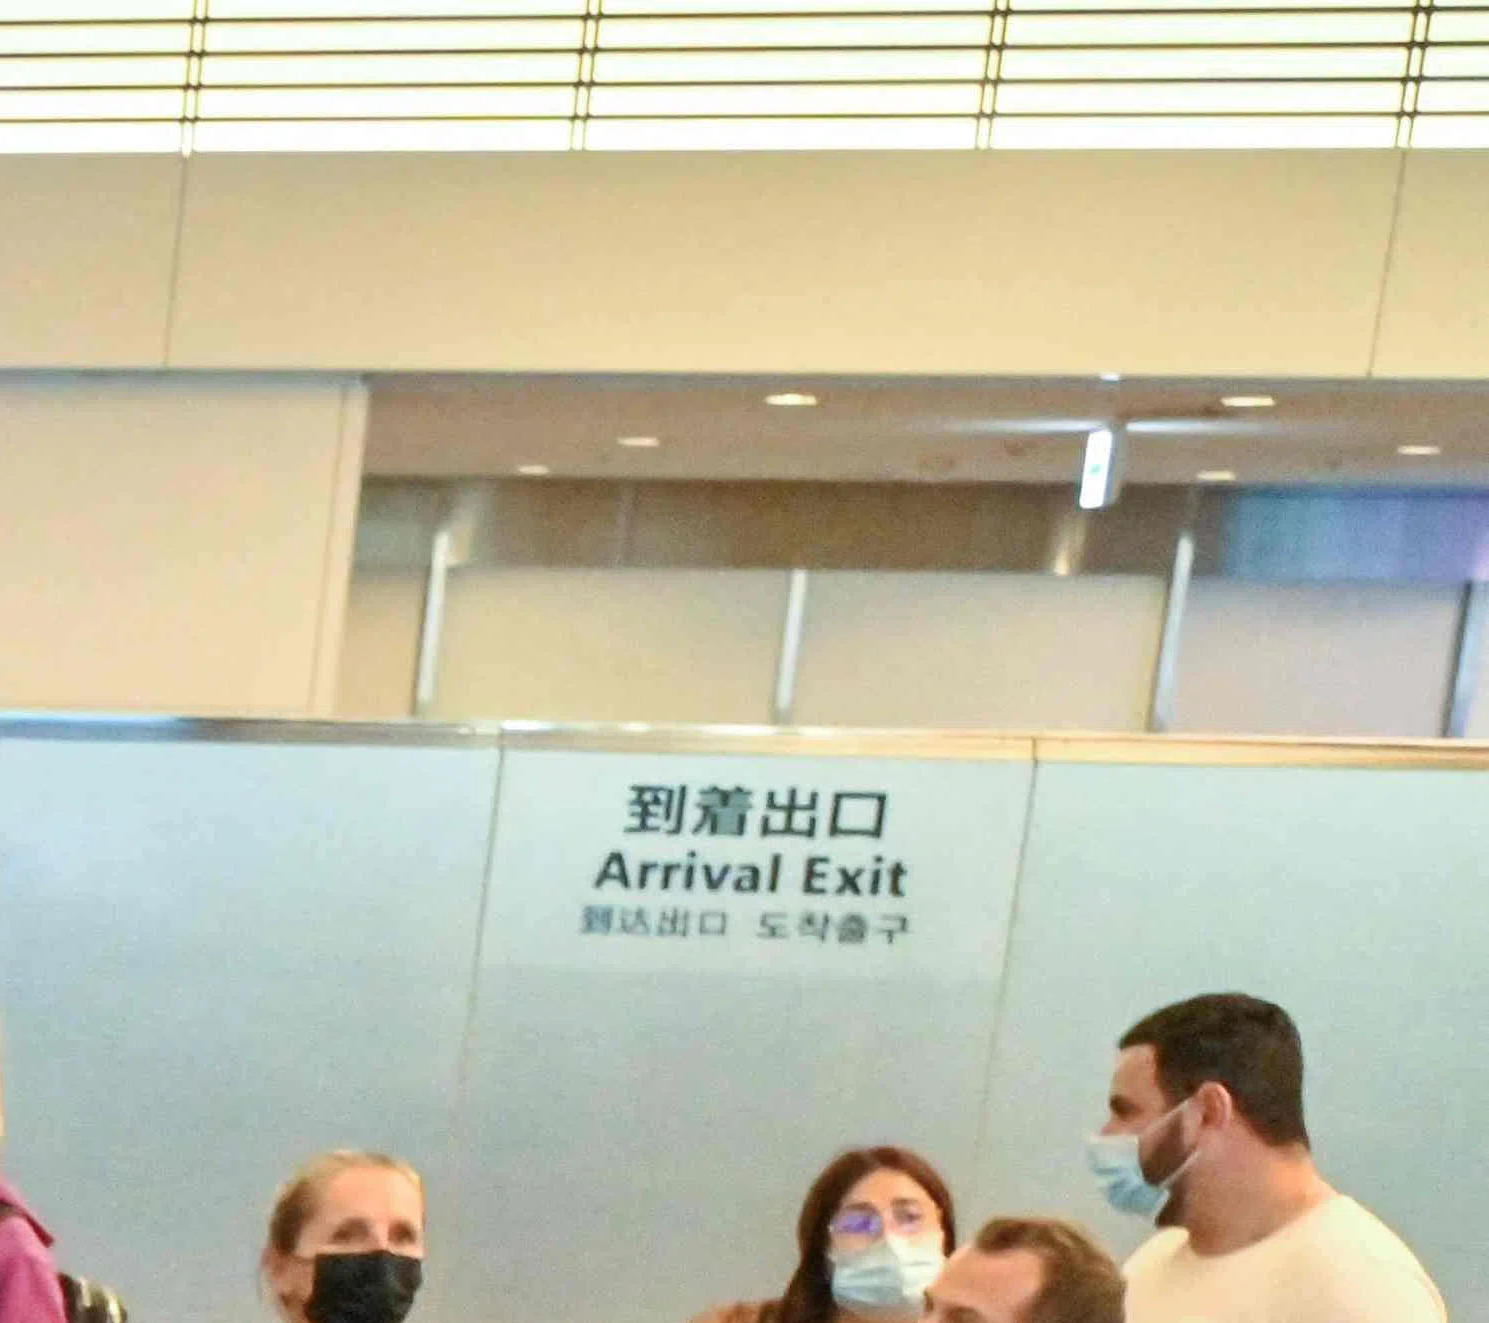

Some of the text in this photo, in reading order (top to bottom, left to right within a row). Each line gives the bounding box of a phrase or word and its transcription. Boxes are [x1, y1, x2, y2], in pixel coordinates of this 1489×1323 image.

[623, 783, 889, 839] 到着出口
[594, 851, 910, 897] Arrival Exit
